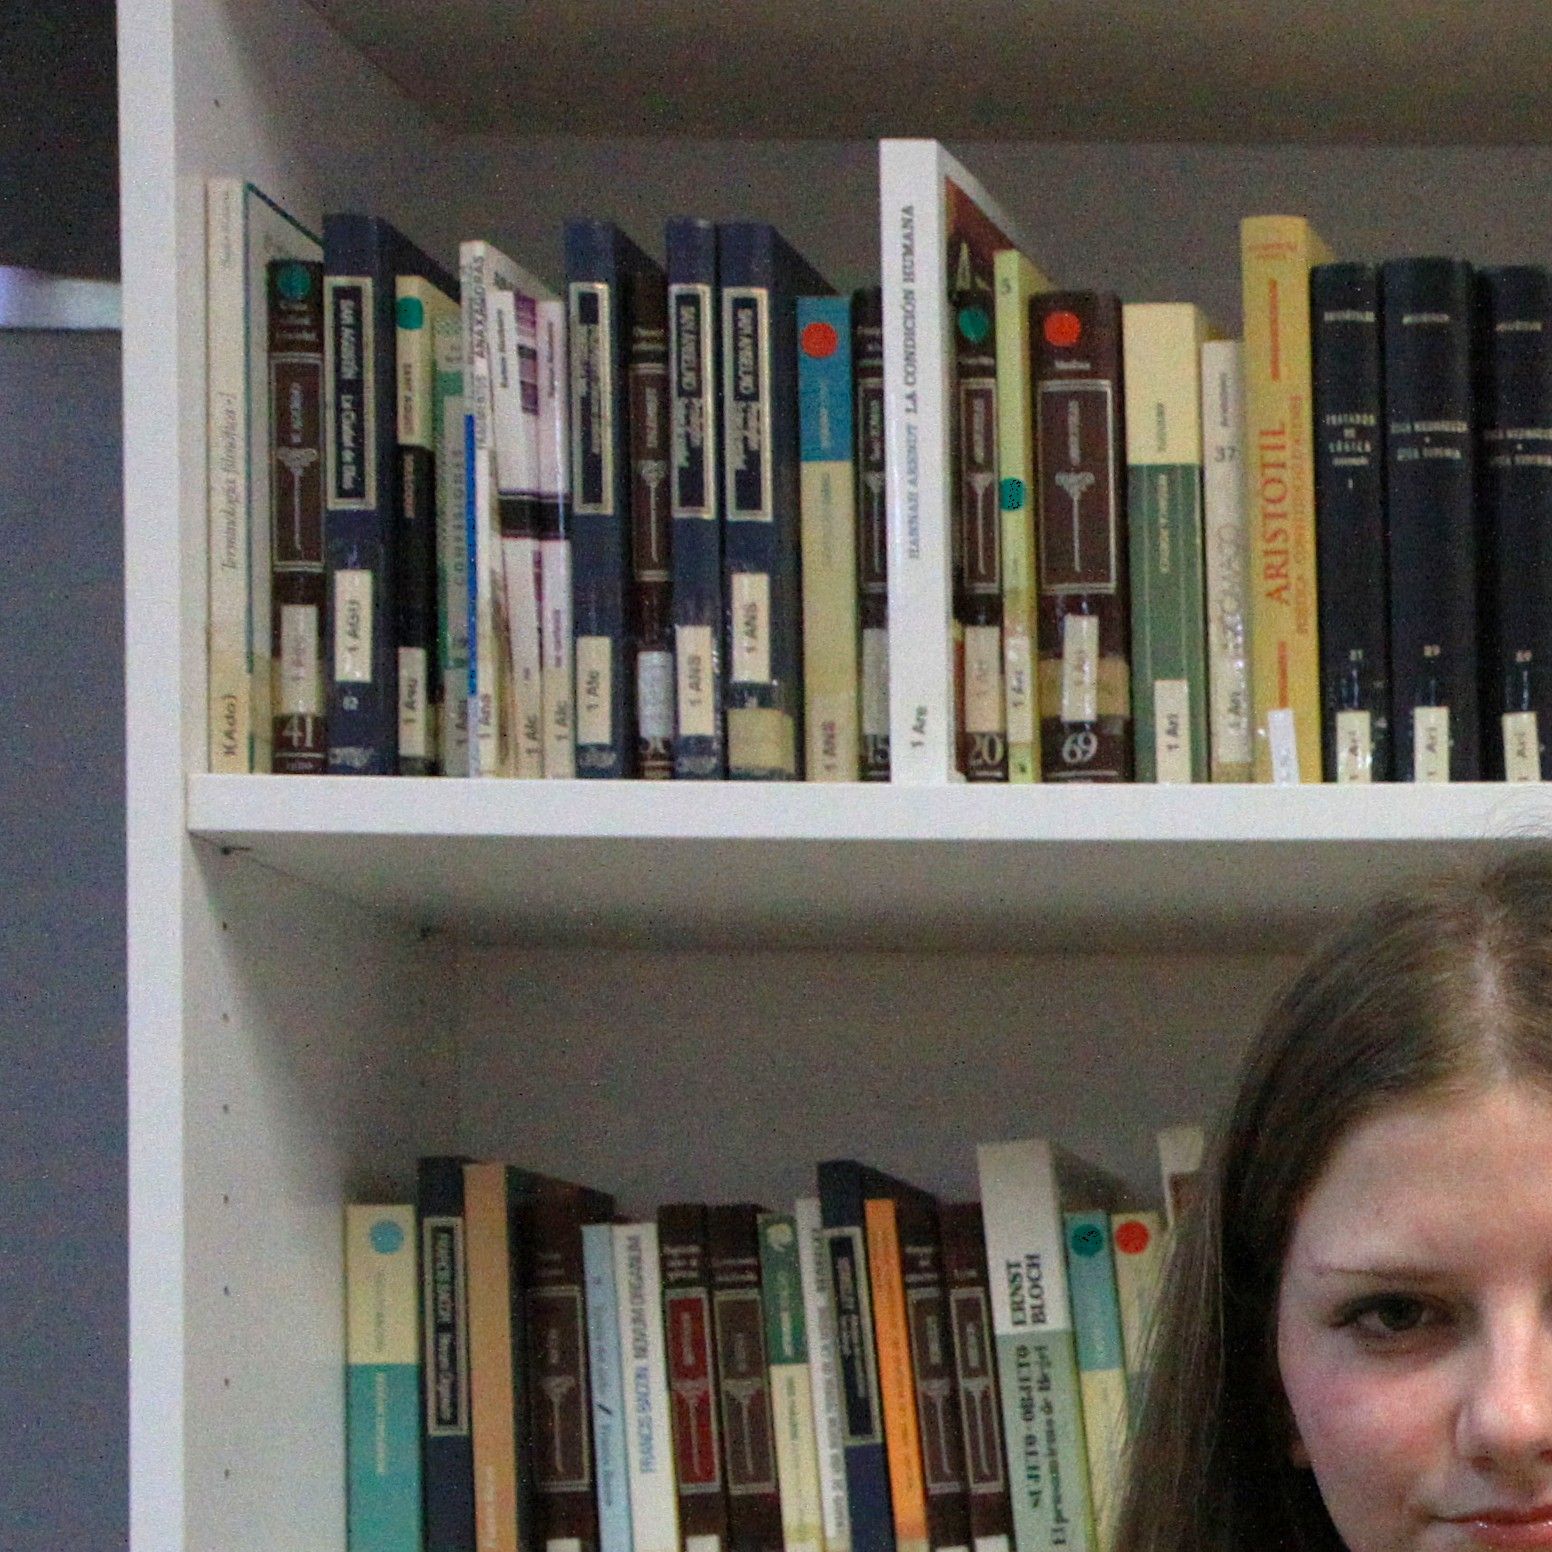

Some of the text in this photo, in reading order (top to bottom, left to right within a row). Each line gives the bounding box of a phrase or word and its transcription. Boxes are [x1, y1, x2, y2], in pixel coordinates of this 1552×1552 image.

[900, 205, 915, 284] HUMANA
[904, 391, 917, 415] LA
[907, 493, 921, 559] HANNAH
[1006, 1260, 1027, 1326] ERNST
[1025, 1254, 1048, 1325] BLOCH
[635, 1366, 654, 1413] BACON
